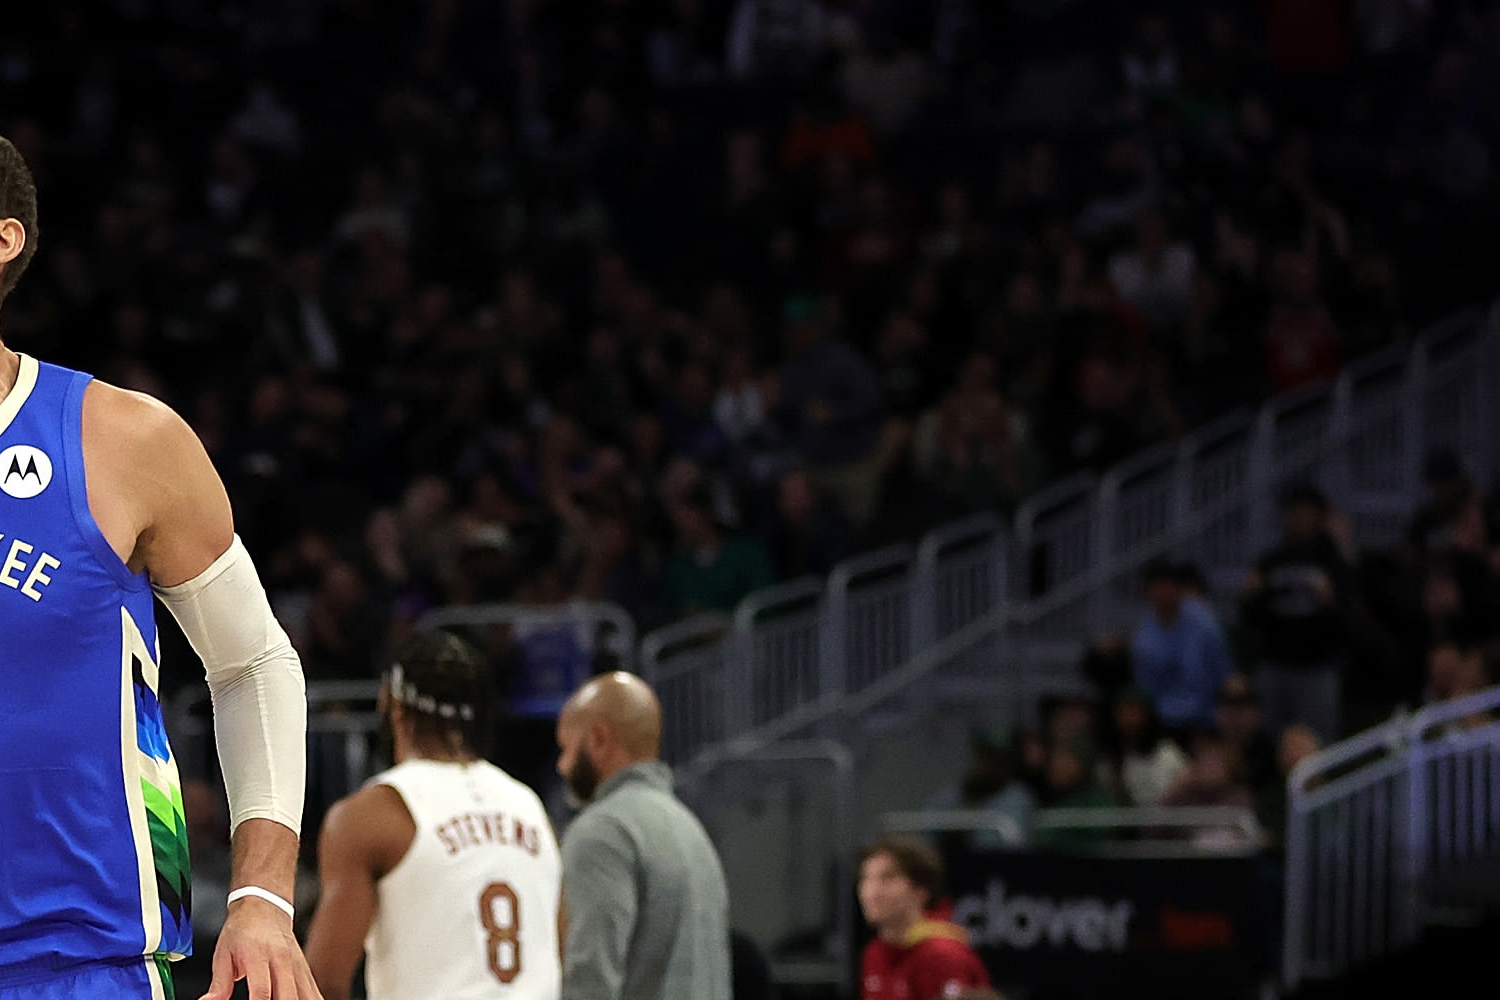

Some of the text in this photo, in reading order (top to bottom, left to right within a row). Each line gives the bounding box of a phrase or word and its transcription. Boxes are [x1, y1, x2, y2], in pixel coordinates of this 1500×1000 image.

[436, 812, 541, 858] STEVENS
[480, 881, 522, 984] 8
[954, 877, 1131, 952] clover
